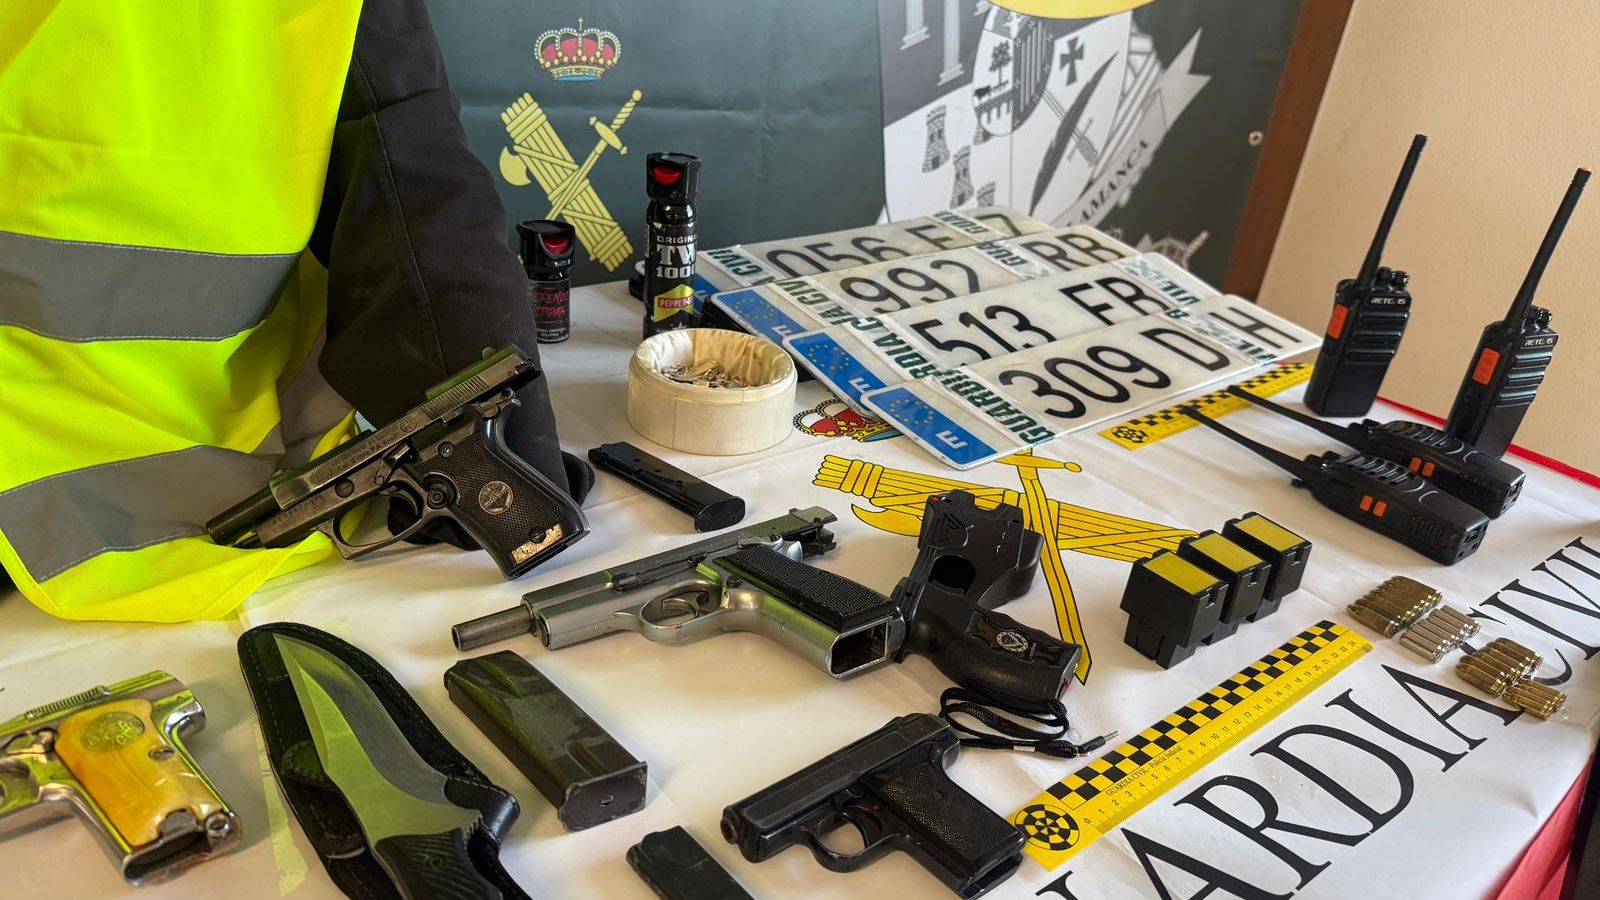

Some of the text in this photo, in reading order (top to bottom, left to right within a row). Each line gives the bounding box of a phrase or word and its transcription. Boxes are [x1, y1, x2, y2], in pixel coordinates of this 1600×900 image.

[1066, 139, 1148, 227] AMANCA
[766, 237, 910, 278] 056
[840, 259, 981, 314] 992
[910, 305, 1057, 367] 513
[1207, 306, 1302, 349] H
[999, 345, 1171, 419] 309
[1138, 327, 1230, 372] D
[936, 430, 969, 449] E
[1036, 664, 1523, 900] ARDIA
[1083, 817, 1092, 825] 0
[1175, 756, 1182, 764] 7
[1210, 732, 1220, 740] 10
[1105, 776, 1134, 796] GUARDIA
[1132, 767, 1149, 780] CIVIL
